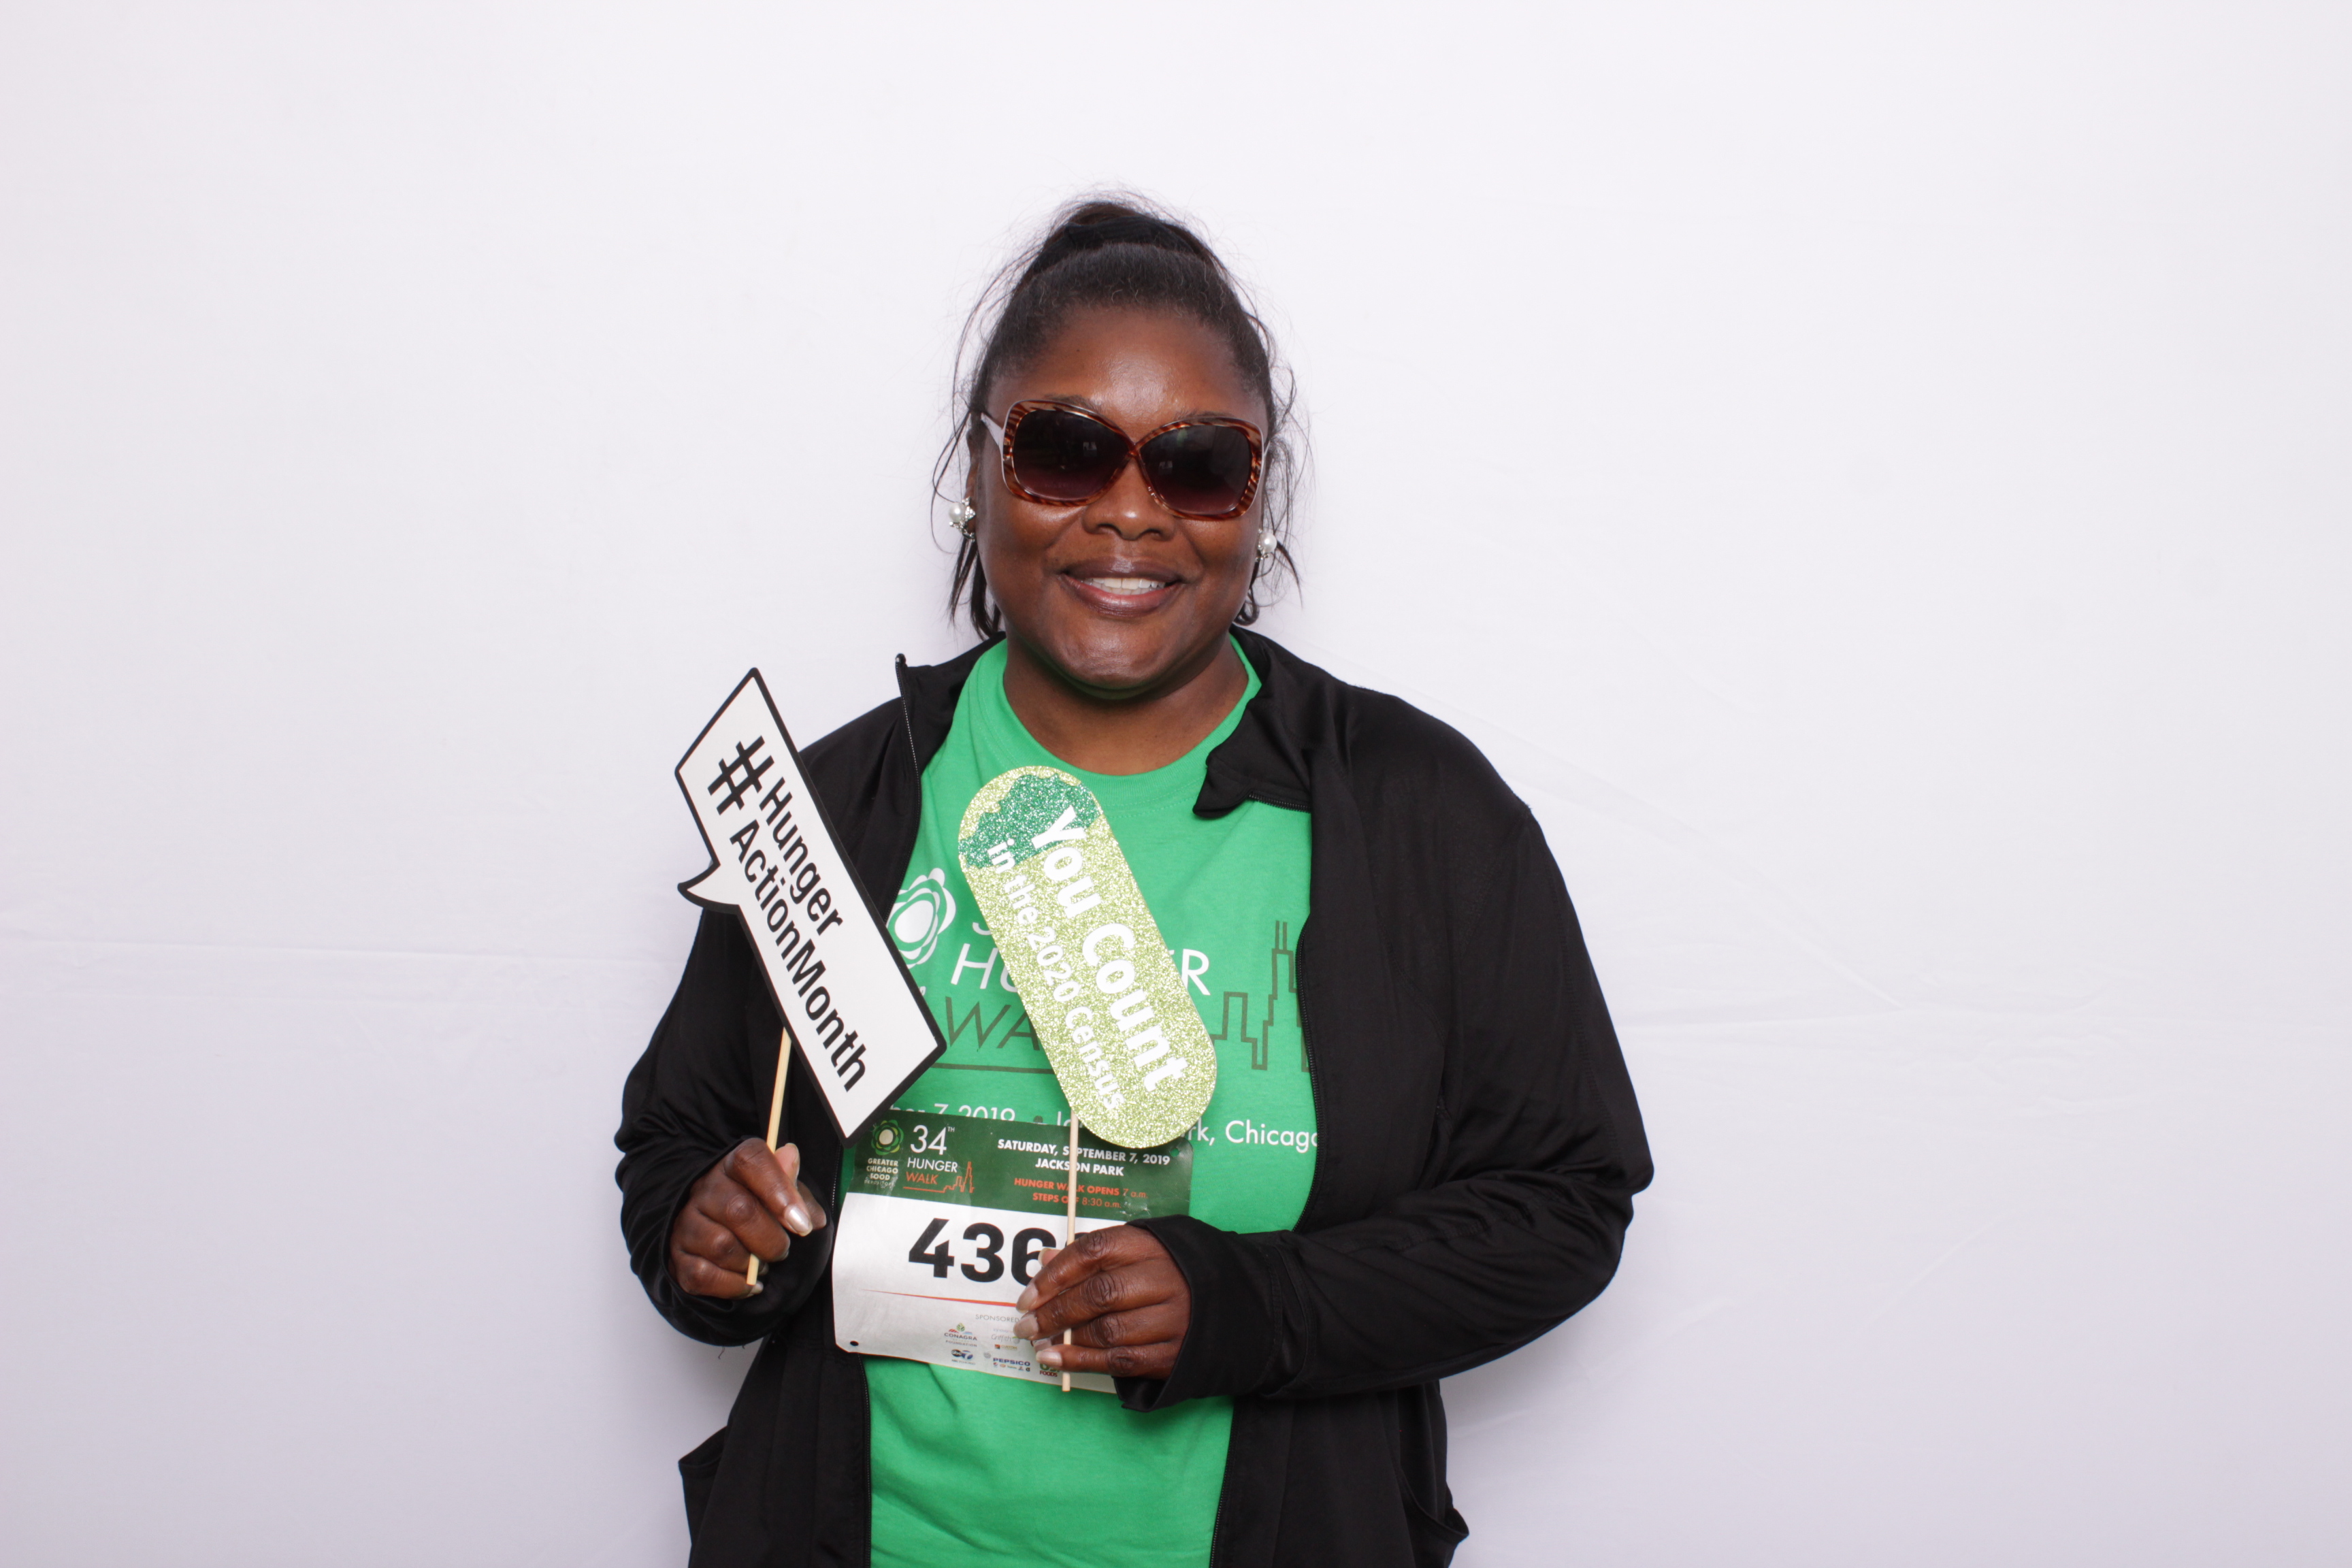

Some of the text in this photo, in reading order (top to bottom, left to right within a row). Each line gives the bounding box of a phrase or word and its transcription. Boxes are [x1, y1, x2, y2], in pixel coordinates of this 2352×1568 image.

[729, 819, 867, 1092] ActionMonth
[1031, 805, 1102, 919] You
[1082, 923, 1189, 1092] Count
[987, 838, 1015, 875] in
[1004, 873, 1039, 925] the
[1027, 926, 1080, 1003] 2020
[1066, 1005, 1126, 1111] Census
[945, 996, 1041, 1051] WA
[997, 1139, 1171, 1165] SATURDAY, SPTEMBER 7, 2019
[867, 1158, 899, 1166] GREATER
[906, 1157, 958, 1173] HUNGER
[866, 1165, 899, 1175] CHICAGO
[870, 1173, 891, 1181] FOOD
[1093, 1164, 1124, 1176] PARK
[905, 1171, 939, 1185] WALK
[1014, 1177, 1149, 1198] HUNGER WK OPENS 7 a.m.
[1032, 1192, 1122, 1209] STEPS OF 8:30 a.m.
[908, 1217, 1092, 1288] 436
[975, 1313, 1021, 1324] SPONSORED
[944, 1333, 978, 1341] CONAGRA
[945, 1339, 977, 1348] FOUNDATION
[991, 1334, 1012, 1342] Griffith
[993, 1357, 1031, 1367] PEPSICO
